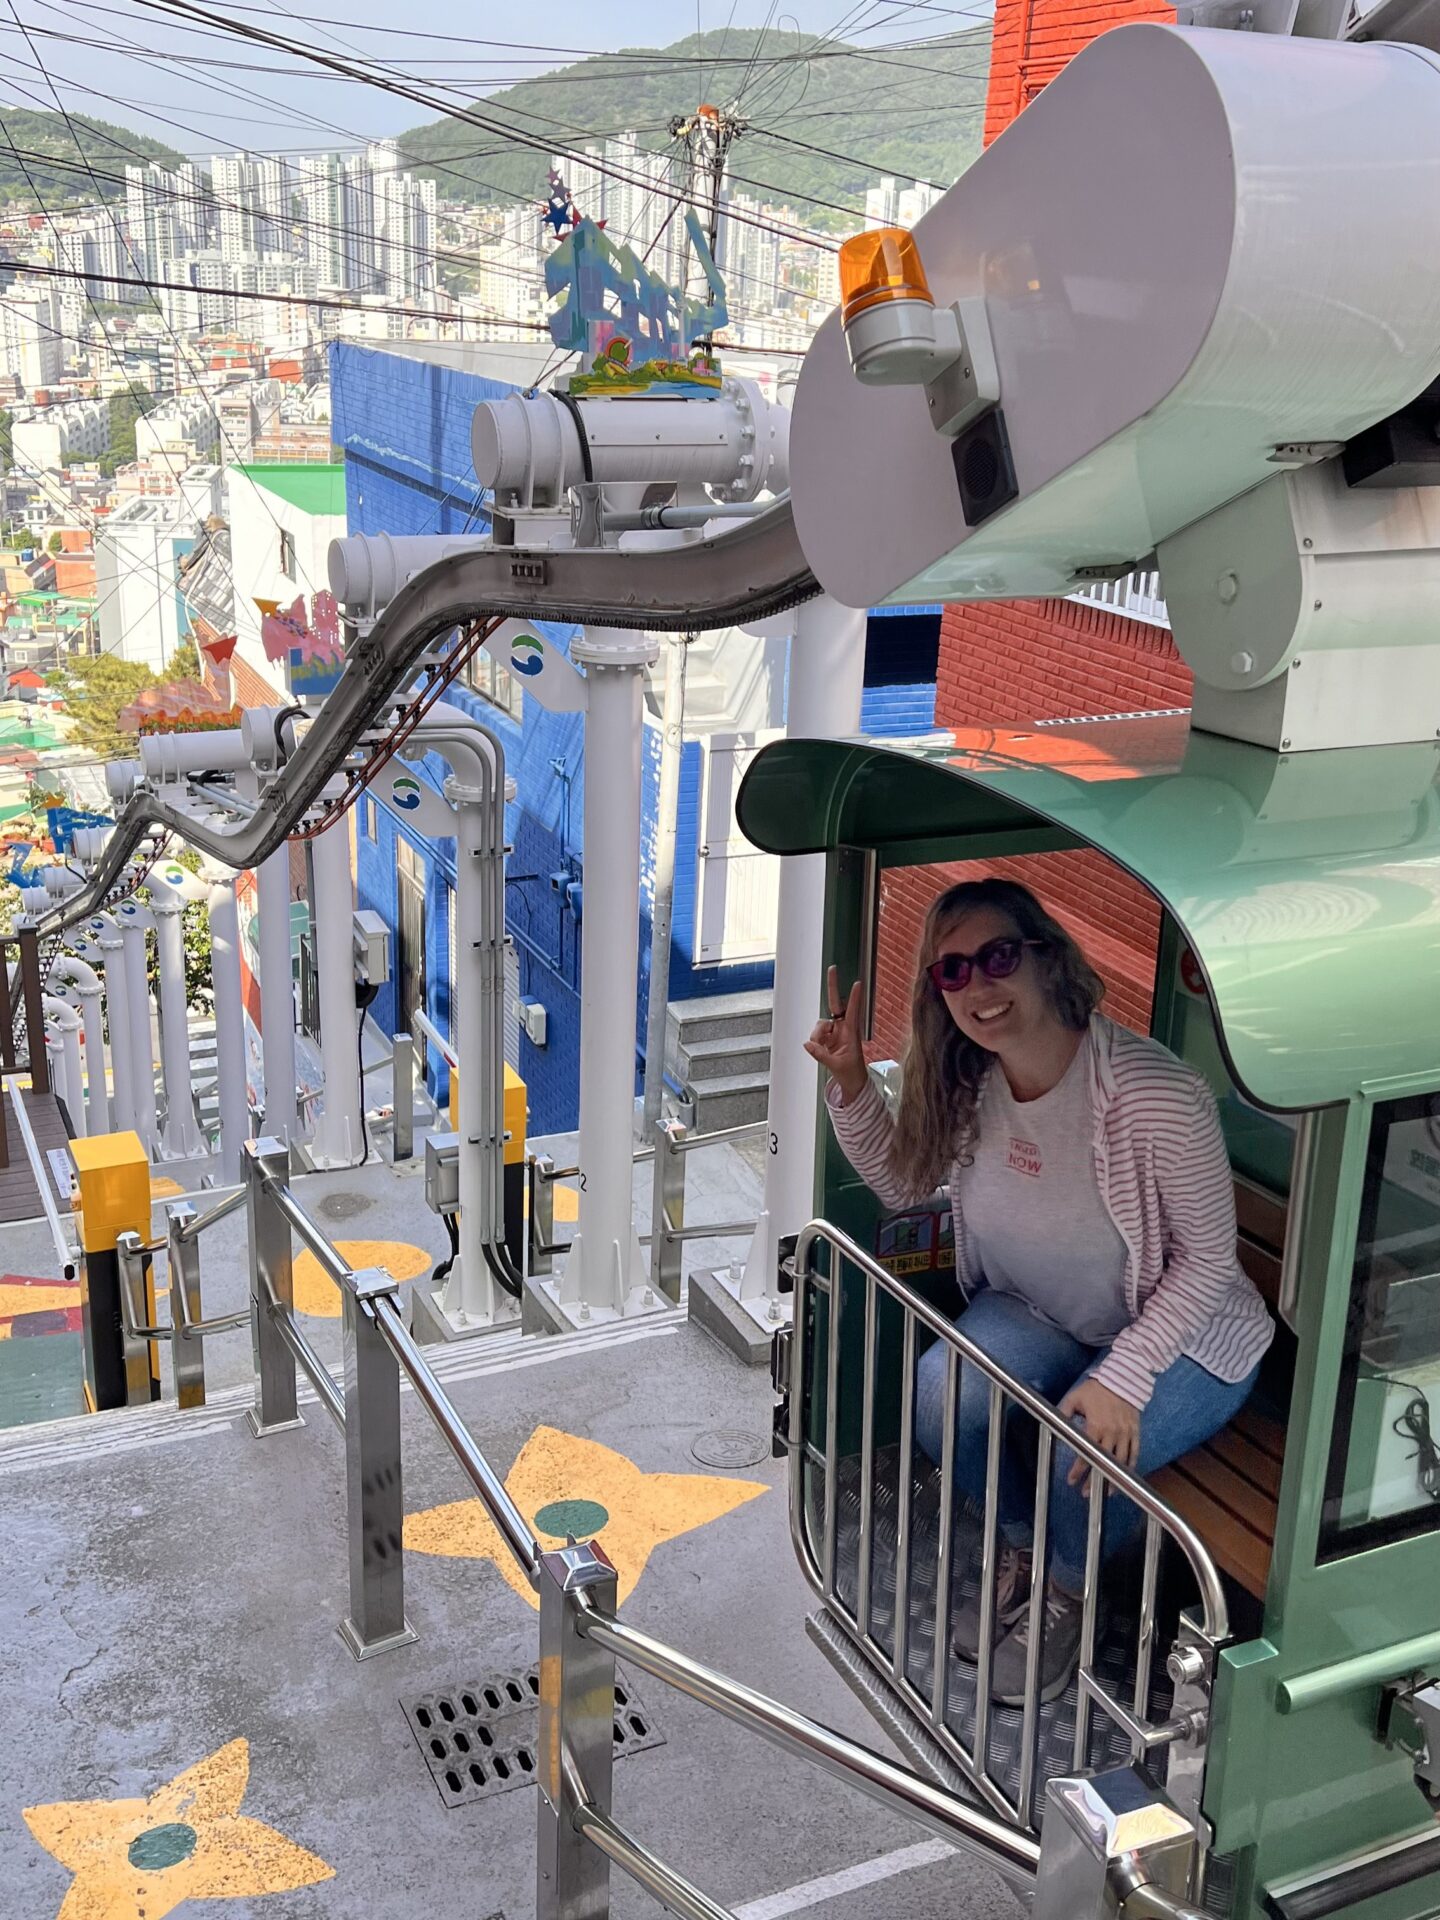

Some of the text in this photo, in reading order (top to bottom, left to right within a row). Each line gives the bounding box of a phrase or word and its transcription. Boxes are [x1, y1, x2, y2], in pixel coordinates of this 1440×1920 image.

[769, 1132, 778, 1155] 3
[1009, 1152, 1042, 1173] NOW
[580, 1173, 587, 1193] 2
